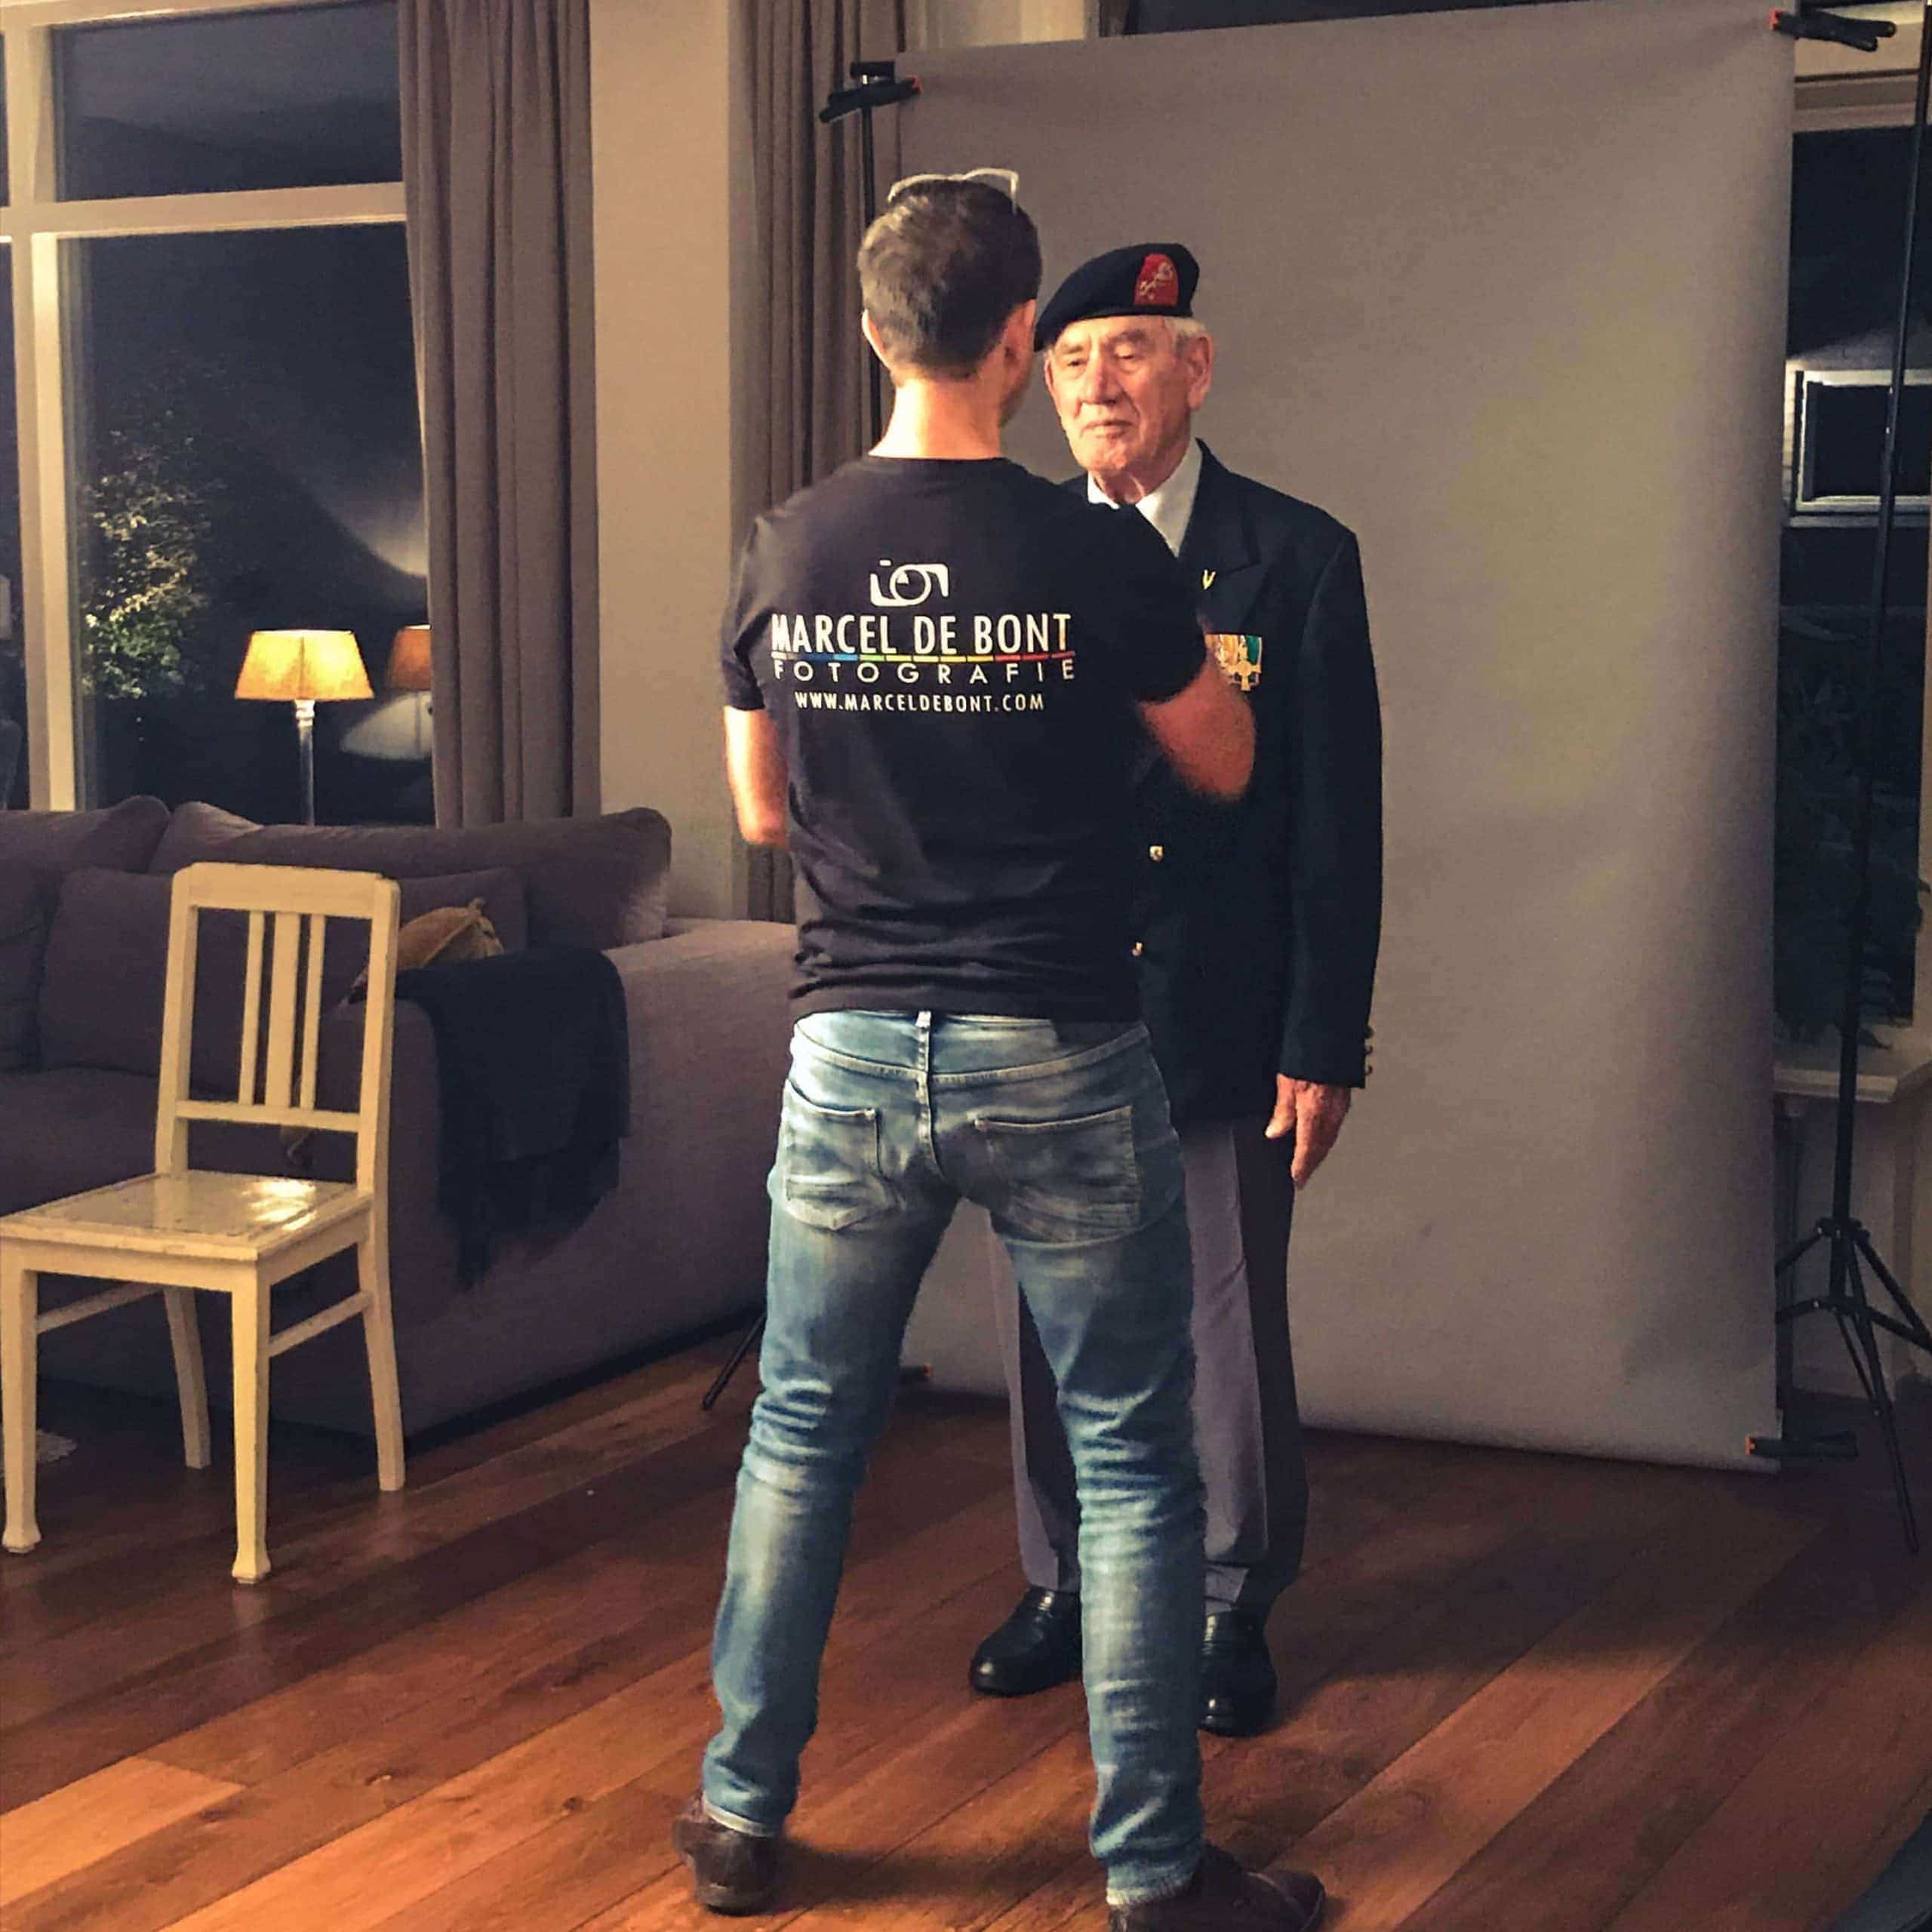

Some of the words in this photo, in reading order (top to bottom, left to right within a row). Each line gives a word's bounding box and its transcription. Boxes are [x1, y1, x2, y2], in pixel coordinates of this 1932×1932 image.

[771, 614, 897, 654] MARCEL
[913, 615, 958, 654] DE
[974, 613, 1072, 654] BONT
[773, 660, 1075, 685] FOTOGRAFIE
[795, 691, 1044, 712] WWW.MARCELDEBONT.COM
